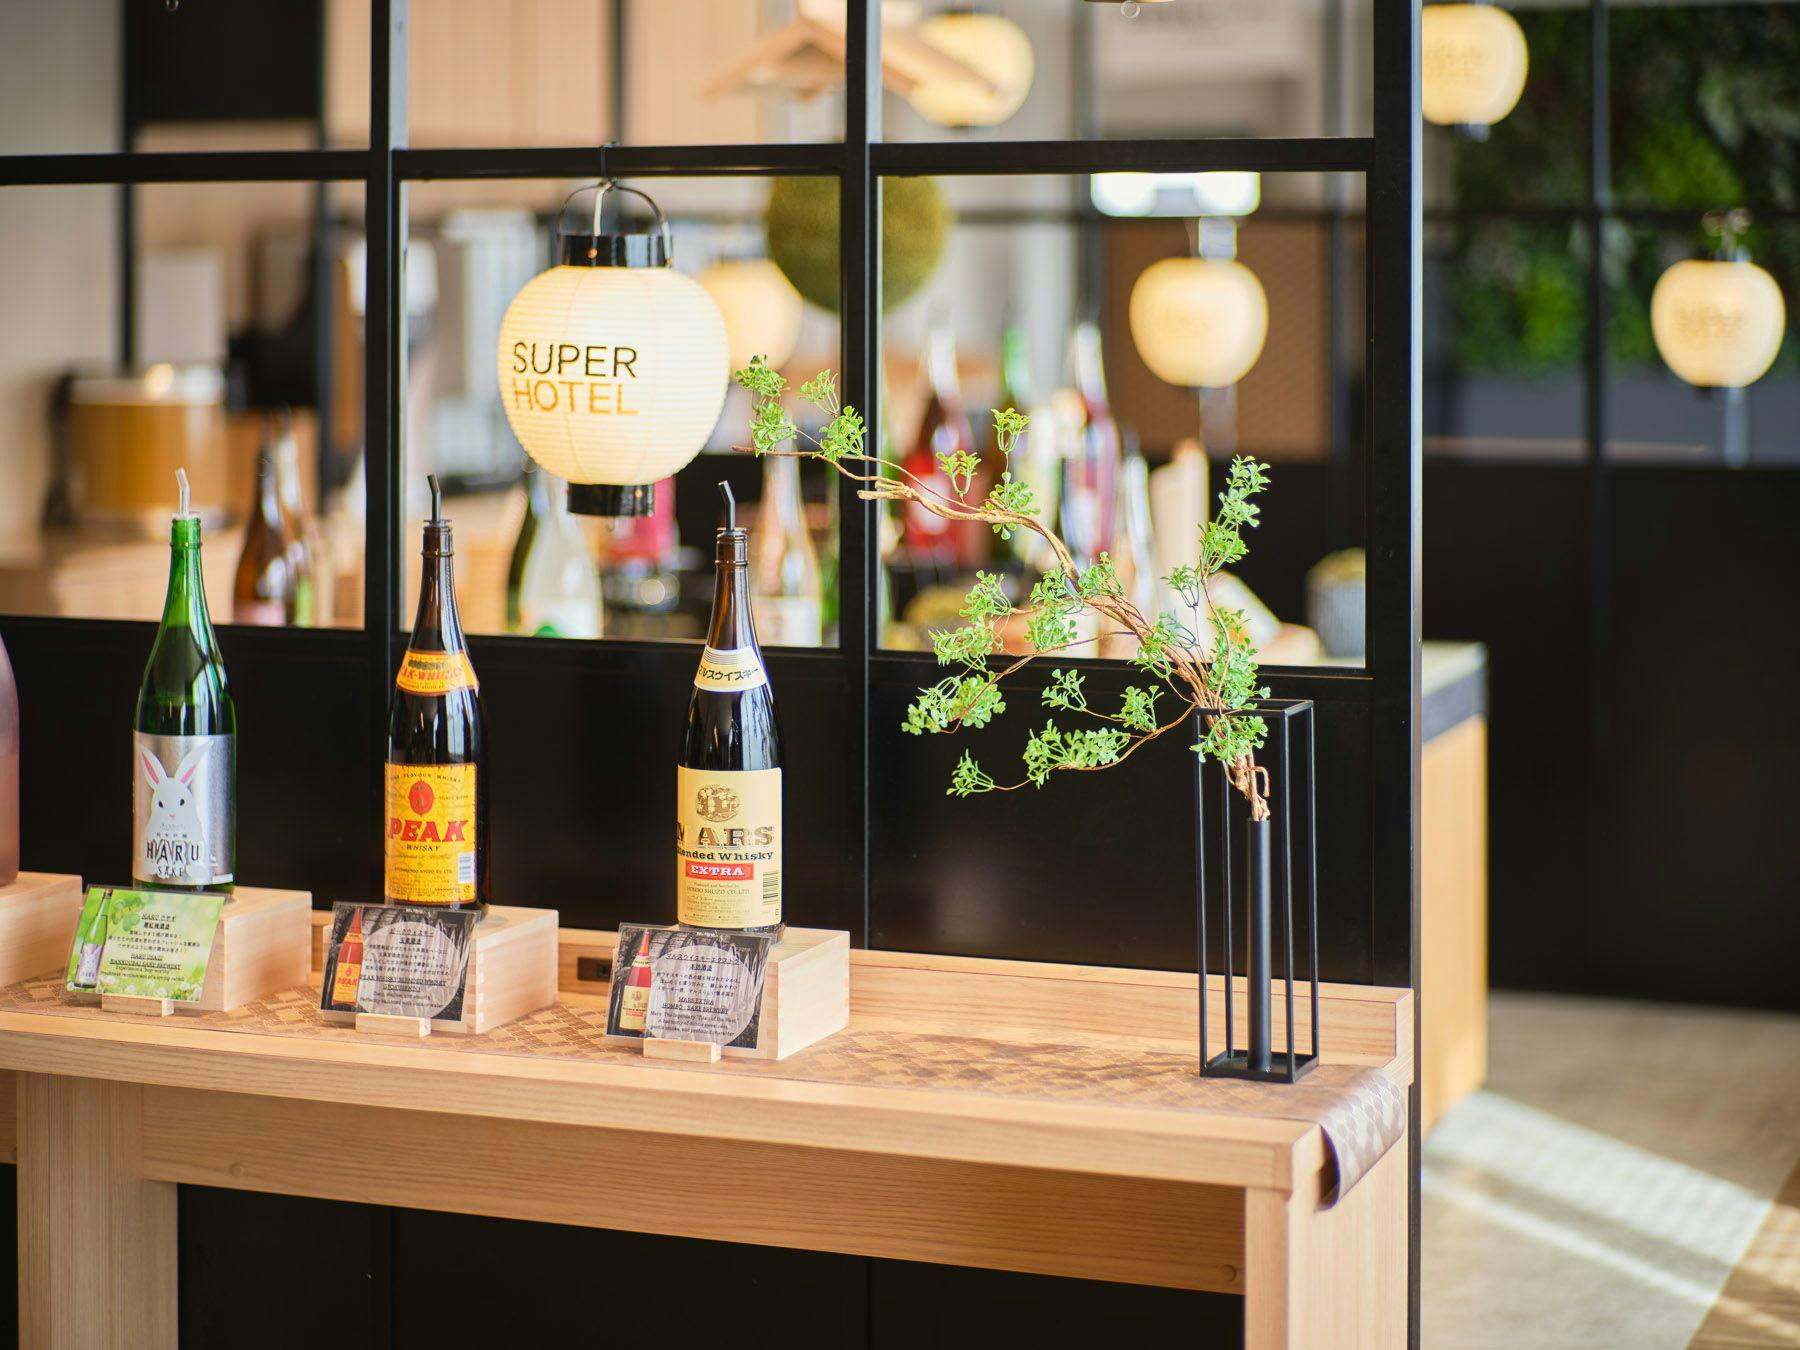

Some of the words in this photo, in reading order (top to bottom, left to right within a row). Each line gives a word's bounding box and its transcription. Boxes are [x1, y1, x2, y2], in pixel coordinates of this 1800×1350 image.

[513, 342, 637, 378] SUPER
[512, 378, 639, 415] HOTEL
[390, 817, 469, 842] PEAK
[146, 840, 200, 862] HARU
[719, 850, 774, 862] Whisky
[690, 865, 745, 877] EXTRA
